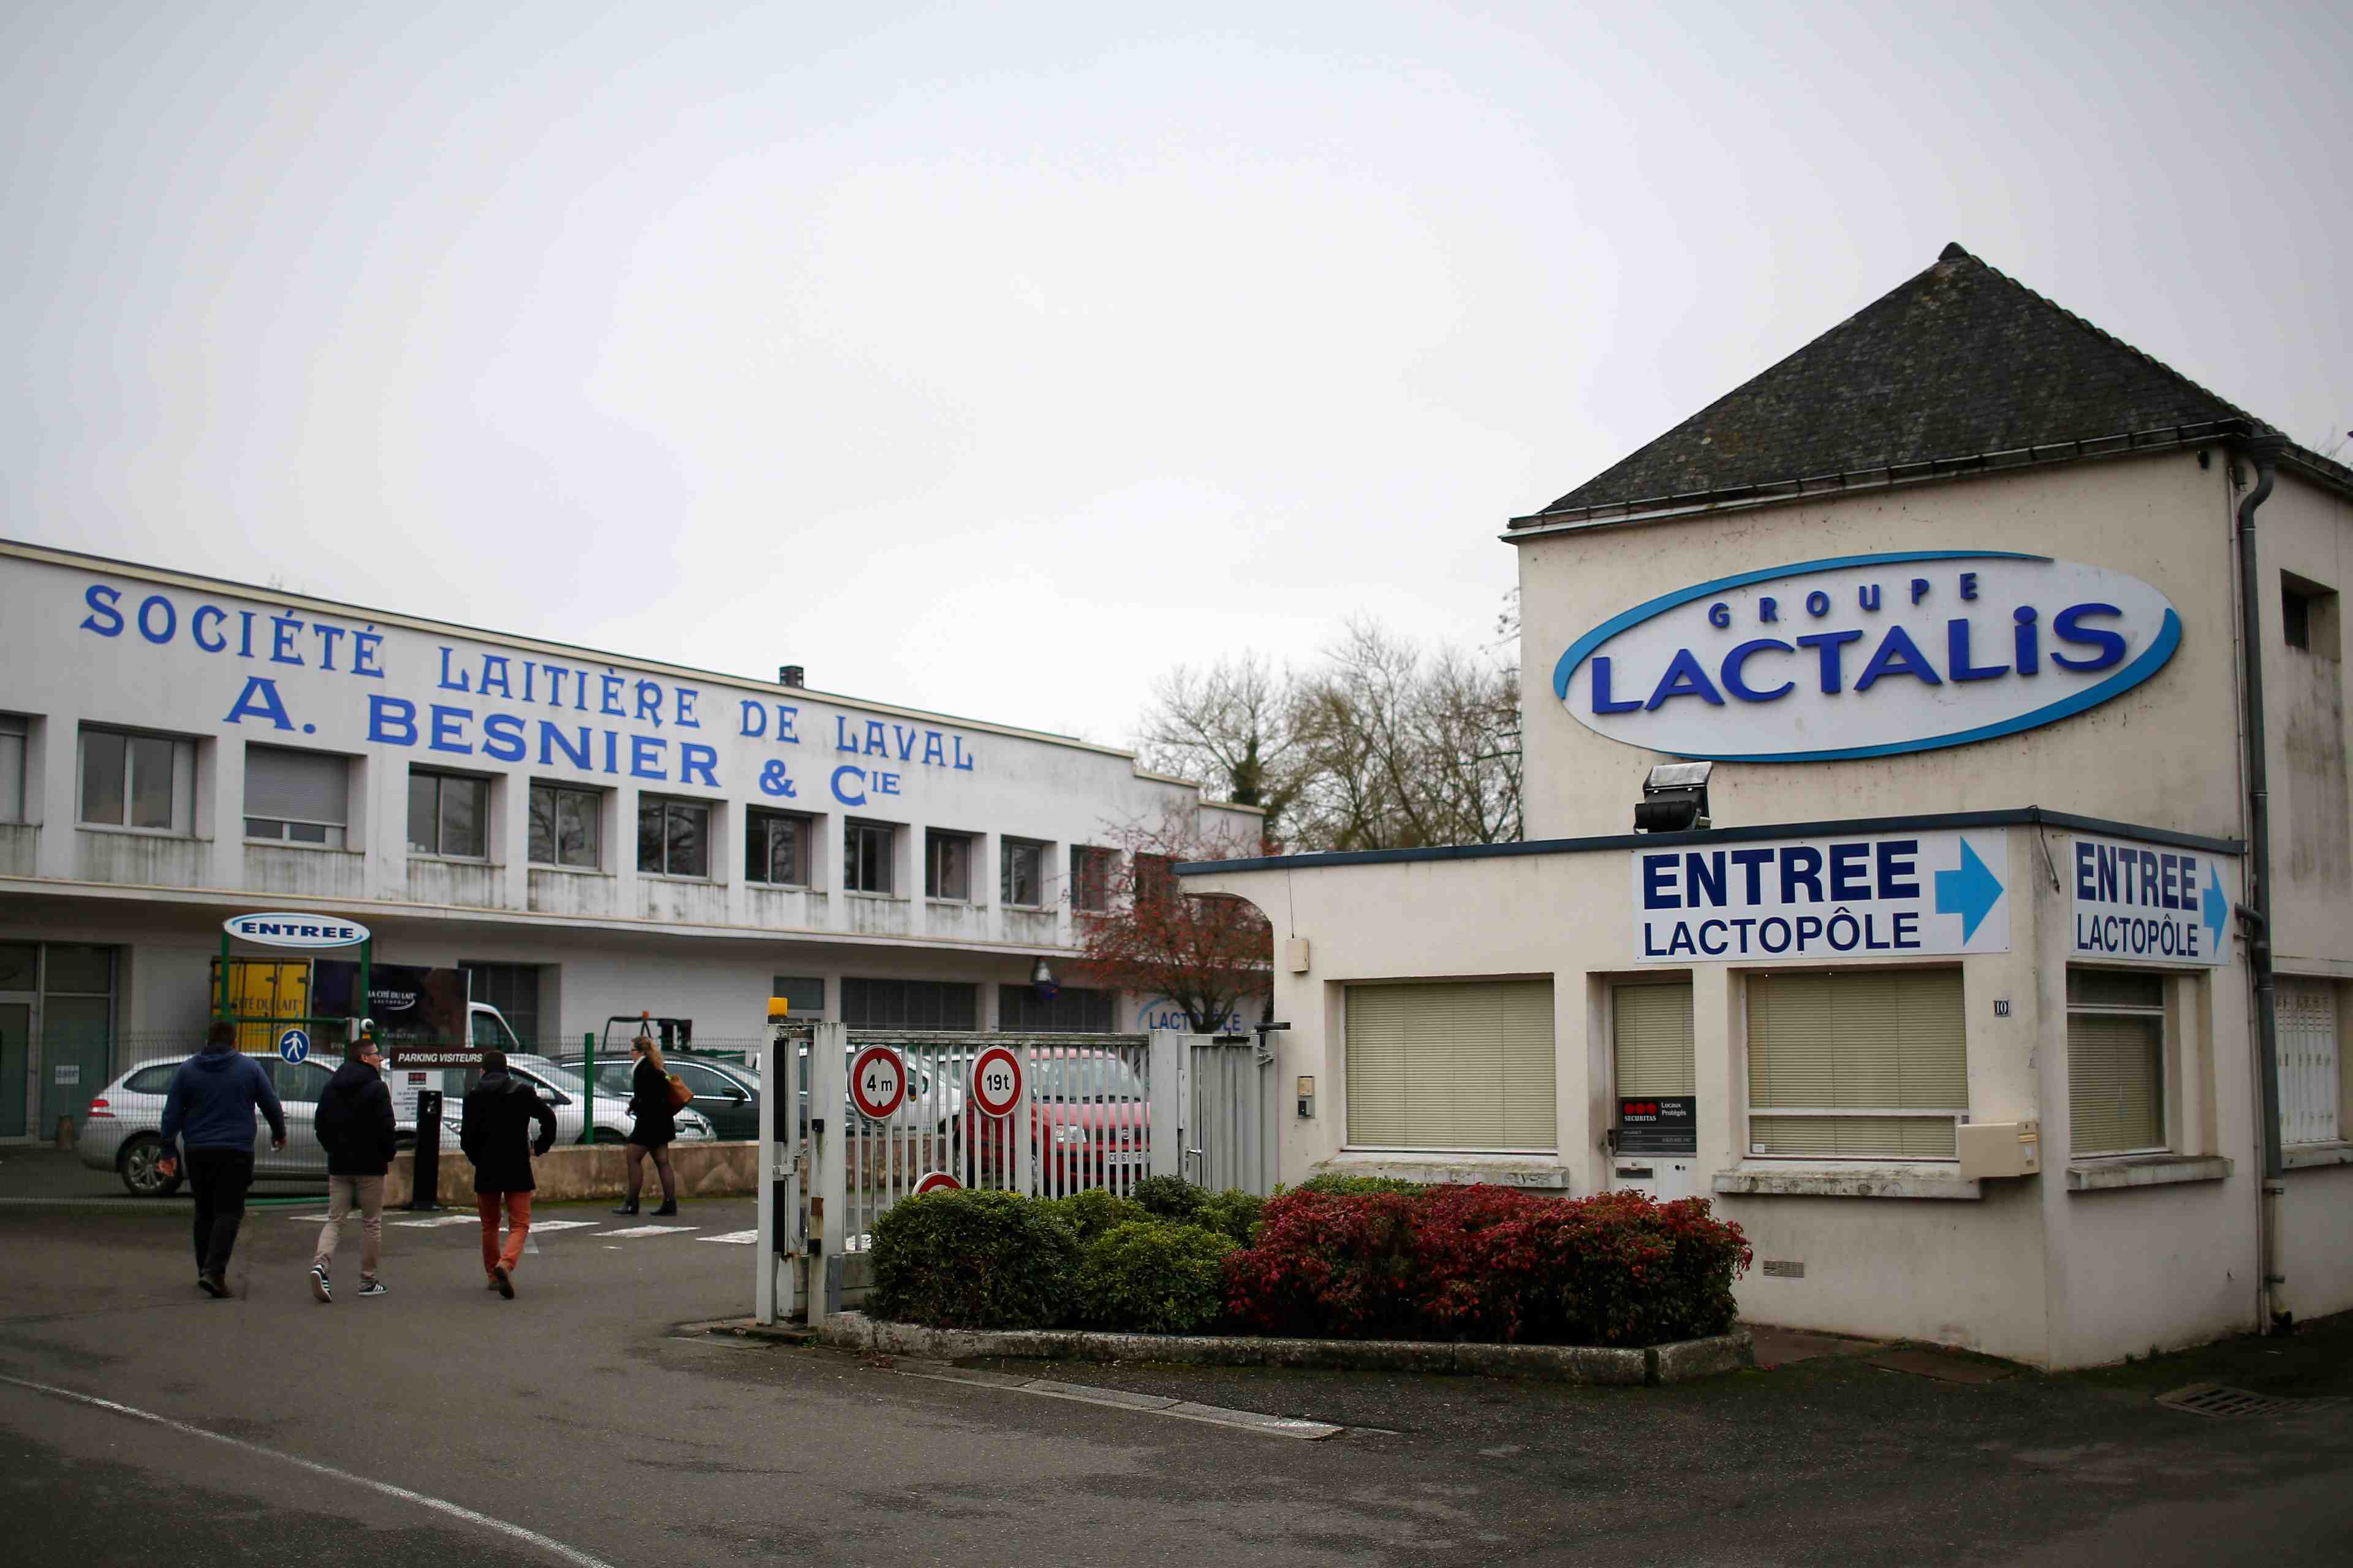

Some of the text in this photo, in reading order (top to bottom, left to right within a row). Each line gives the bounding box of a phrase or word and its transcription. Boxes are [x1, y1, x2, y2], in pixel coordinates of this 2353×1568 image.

[1708, 572, 1979, 628] GROUPE
[79, 584, 974, 771] SOCIÉTÉ LAITIÈRE DE LAVAL
[223, 676, 316, 734] A.
[366, 694, 722, 788] BESNIER
[759, 759, 797, 798] &
[1643, 839, 1920, 910] ENTREE
[2075, 841, 2199, 911] ENTREE
[241, 922, 354, 938] ENTREE
[1645, 907, 1920, 956] LACTOPÔLE
[2077, 913, 2199, 957] LACTOPÔLE
[1996, 1001, 2007, 1013] 10
[398, 1053, 483, 1062] PARKING VISITEURS
[866, 1074, 893, 1091] 4 m
